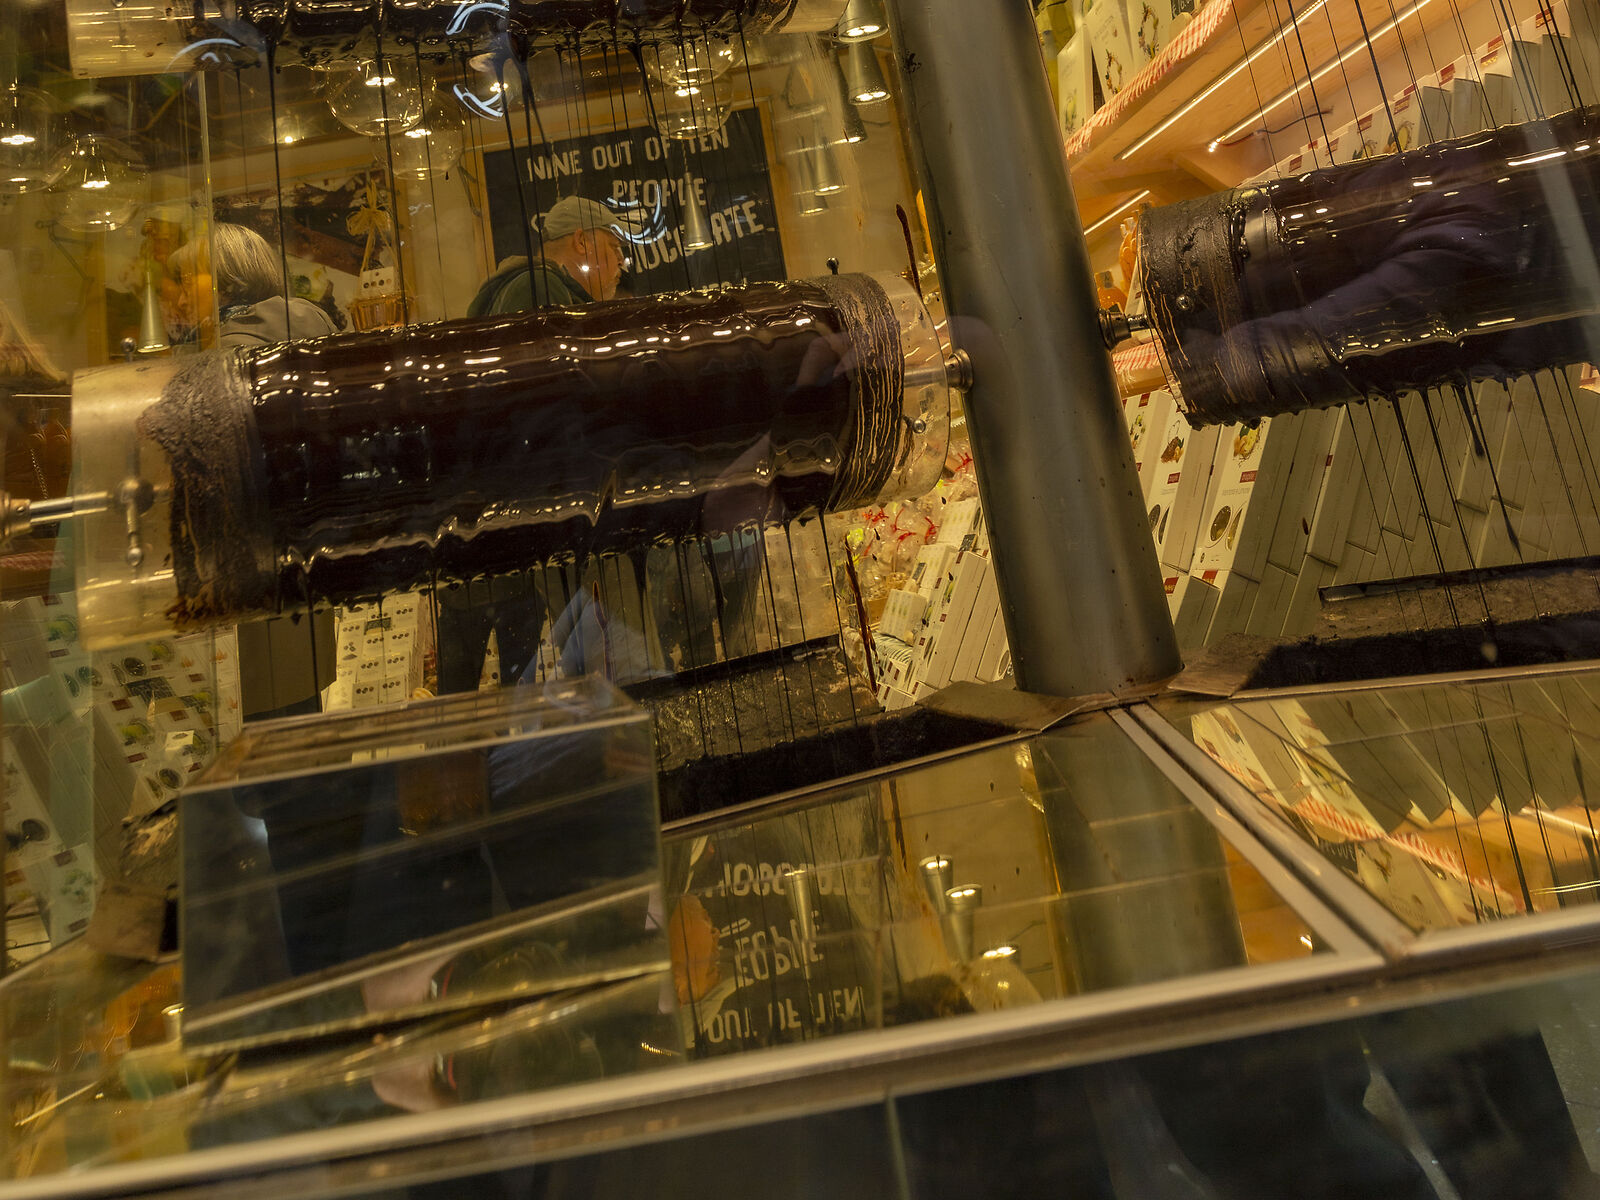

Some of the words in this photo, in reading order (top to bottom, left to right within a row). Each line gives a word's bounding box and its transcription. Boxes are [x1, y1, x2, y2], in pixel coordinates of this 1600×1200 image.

[526, 149, 583, 183] NINE
[592, 140, 633, 170] OUT
[644, 136, 671, 161] OF
[687, 124, 729, 155] TEN
[612, 178, 707, 208] PEOPLE
